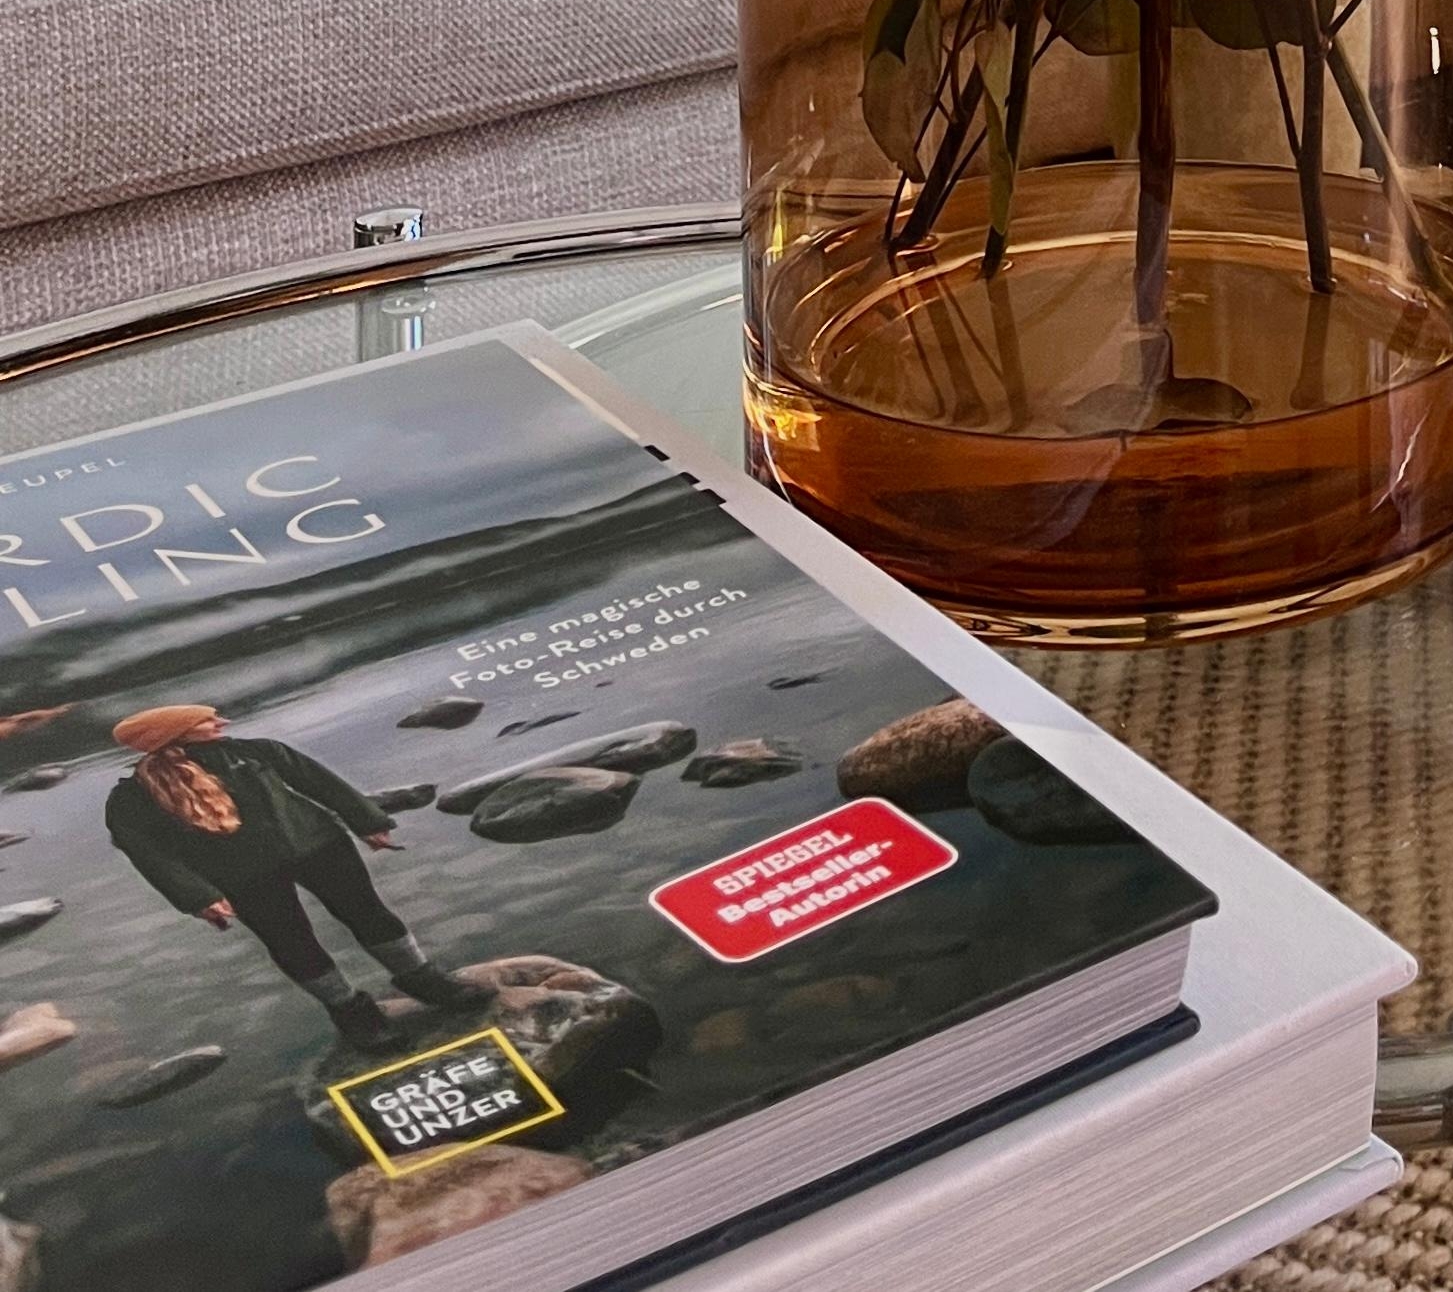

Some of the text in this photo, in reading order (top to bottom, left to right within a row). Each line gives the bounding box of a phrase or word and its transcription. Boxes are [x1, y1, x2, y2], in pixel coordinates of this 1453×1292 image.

[3, 498, 387, 629] LING
[449, 587, 747, 689] Foto-Reise durch
[456, 580, 701, 661] Eine magische
[533, 625, 710, 688] Schweden
[712, 829, 854, 896] SPIEGEL
[717, 840, 894, 924] Bestseller-
[768, 864, 893, 928] Autorin
[370, 1056, 496, 1112] GRÄFE
[381, 1089, 467, 1129] UND
[393, 1089, 522, 1145] UNZER
